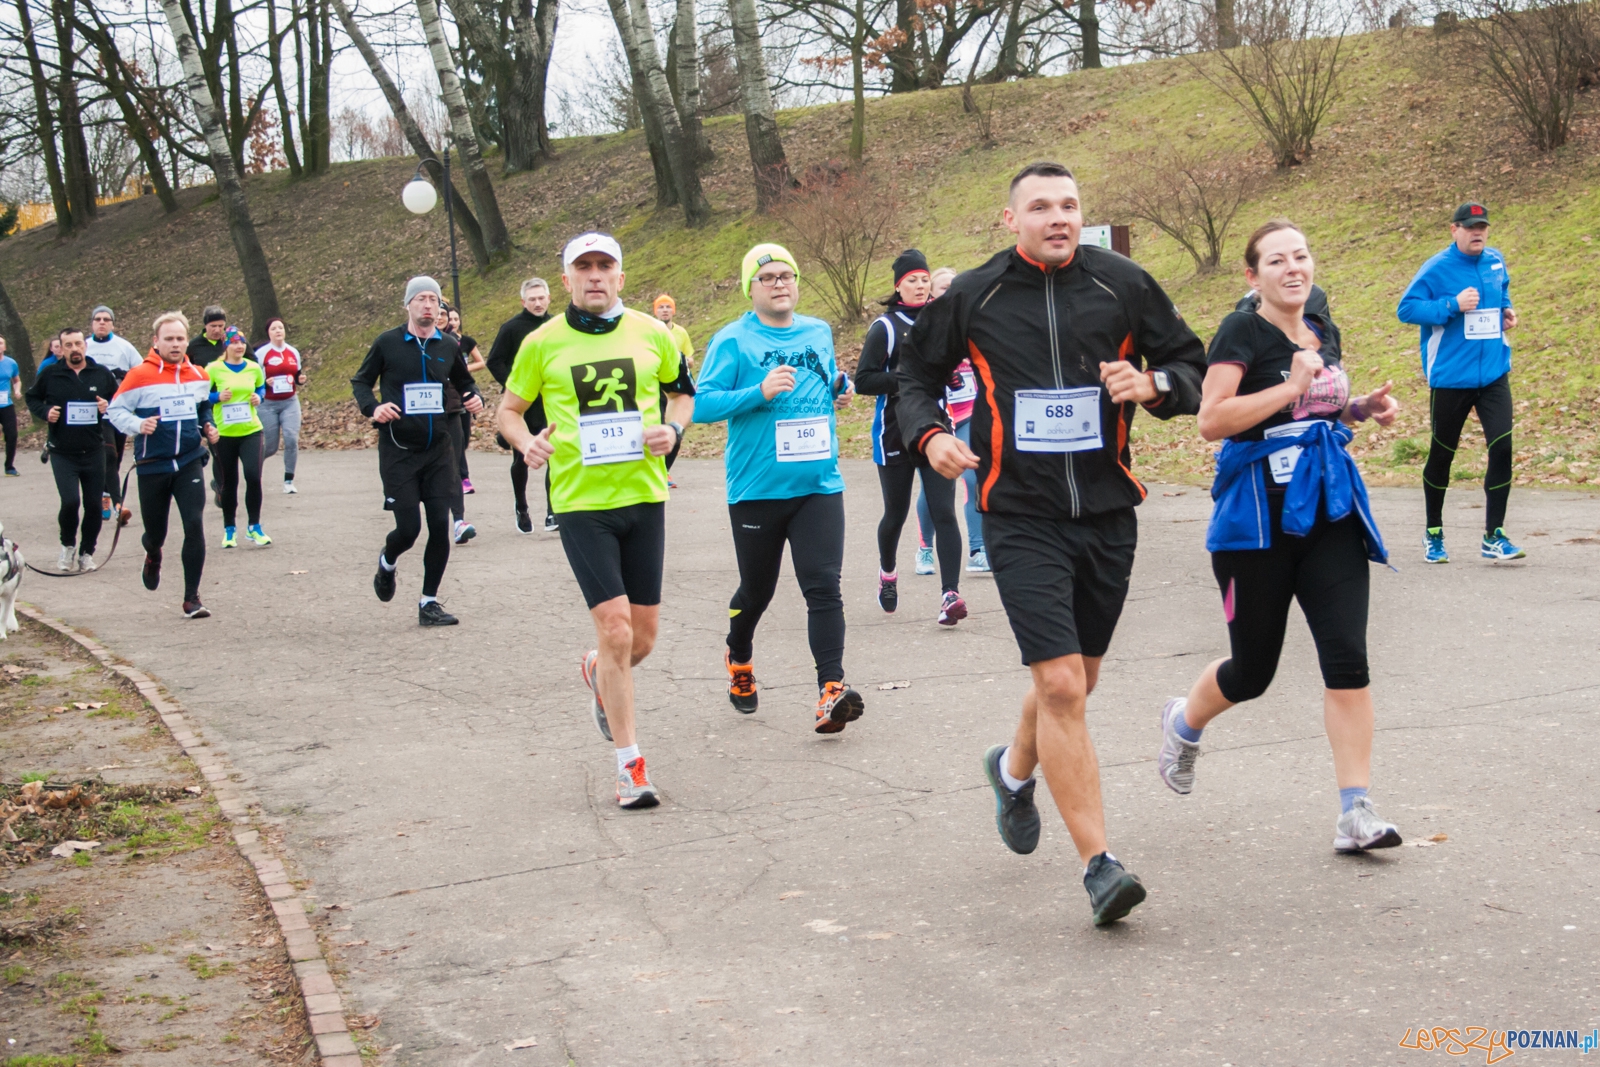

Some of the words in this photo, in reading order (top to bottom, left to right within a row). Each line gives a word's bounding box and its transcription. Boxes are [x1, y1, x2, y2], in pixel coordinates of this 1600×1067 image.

[172, 399, 186, 407] 588
[793, 397, 819, 405] GRAND
[1045, 404, 1074, 418] 688
[601, 426, 624, 439] 913
[797, 427, 815, 439] 160
